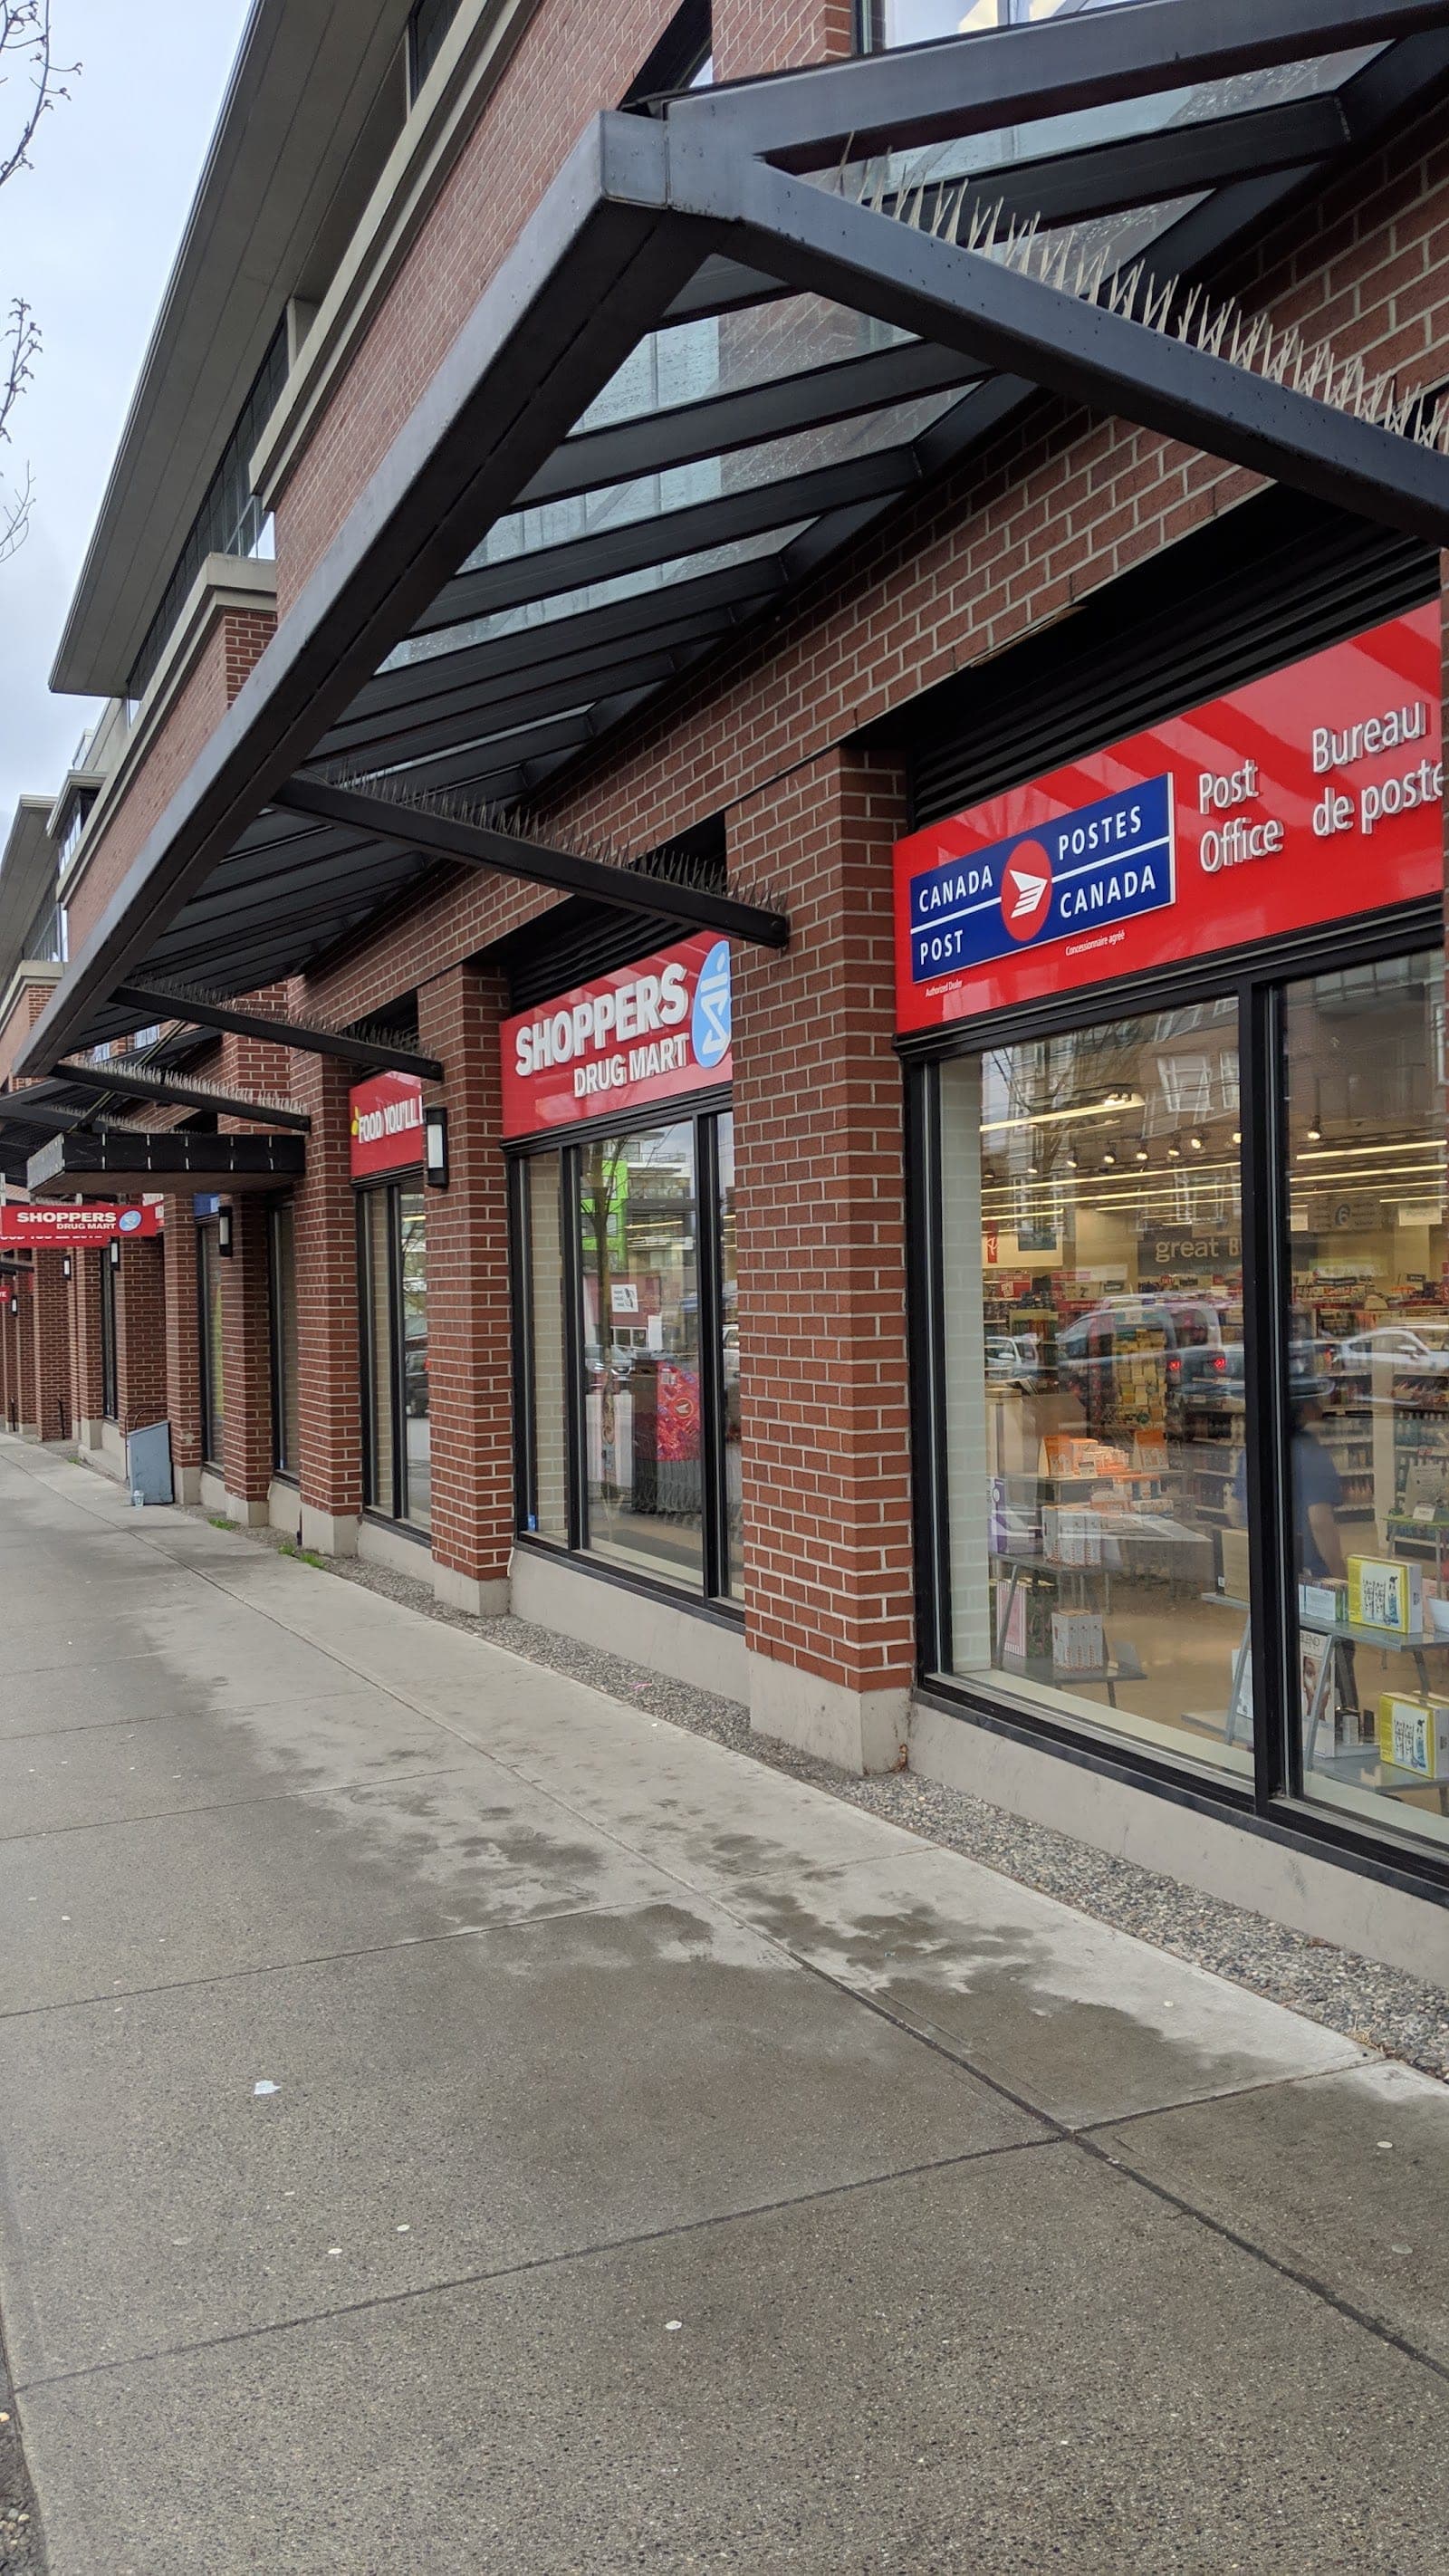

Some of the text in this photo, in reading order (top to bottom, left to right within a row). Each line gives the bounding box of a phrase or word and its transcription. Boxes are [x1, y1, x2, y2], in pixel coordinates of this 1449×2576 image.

[1312, 702, 1427, 773] Bureau
[1199, 759, 1259, 814] Post
[1313, 787, 1354, 837] de
[1058, 805, 1142, 860] POSTES
[1199, 817, 1284, 872] Office
[918, 865, 993, 912] CANADA
[1060, 865, 1156, 918] CANADA
[919, 930, 964, 965] POST
[1065, 936, 1108, 956] Concessionnaire
[515, 963, 688, 1076] SHOPPERS
[574, 1033, 689, 1097] DRUG MART
[358, 1110, 383, 1144] FOOD
[384, 1098, 419, 1135] YOU'LL
[17, 1212, 117, 1223] SHOPPERS
[1155, 1237, 1219, 1263] great
